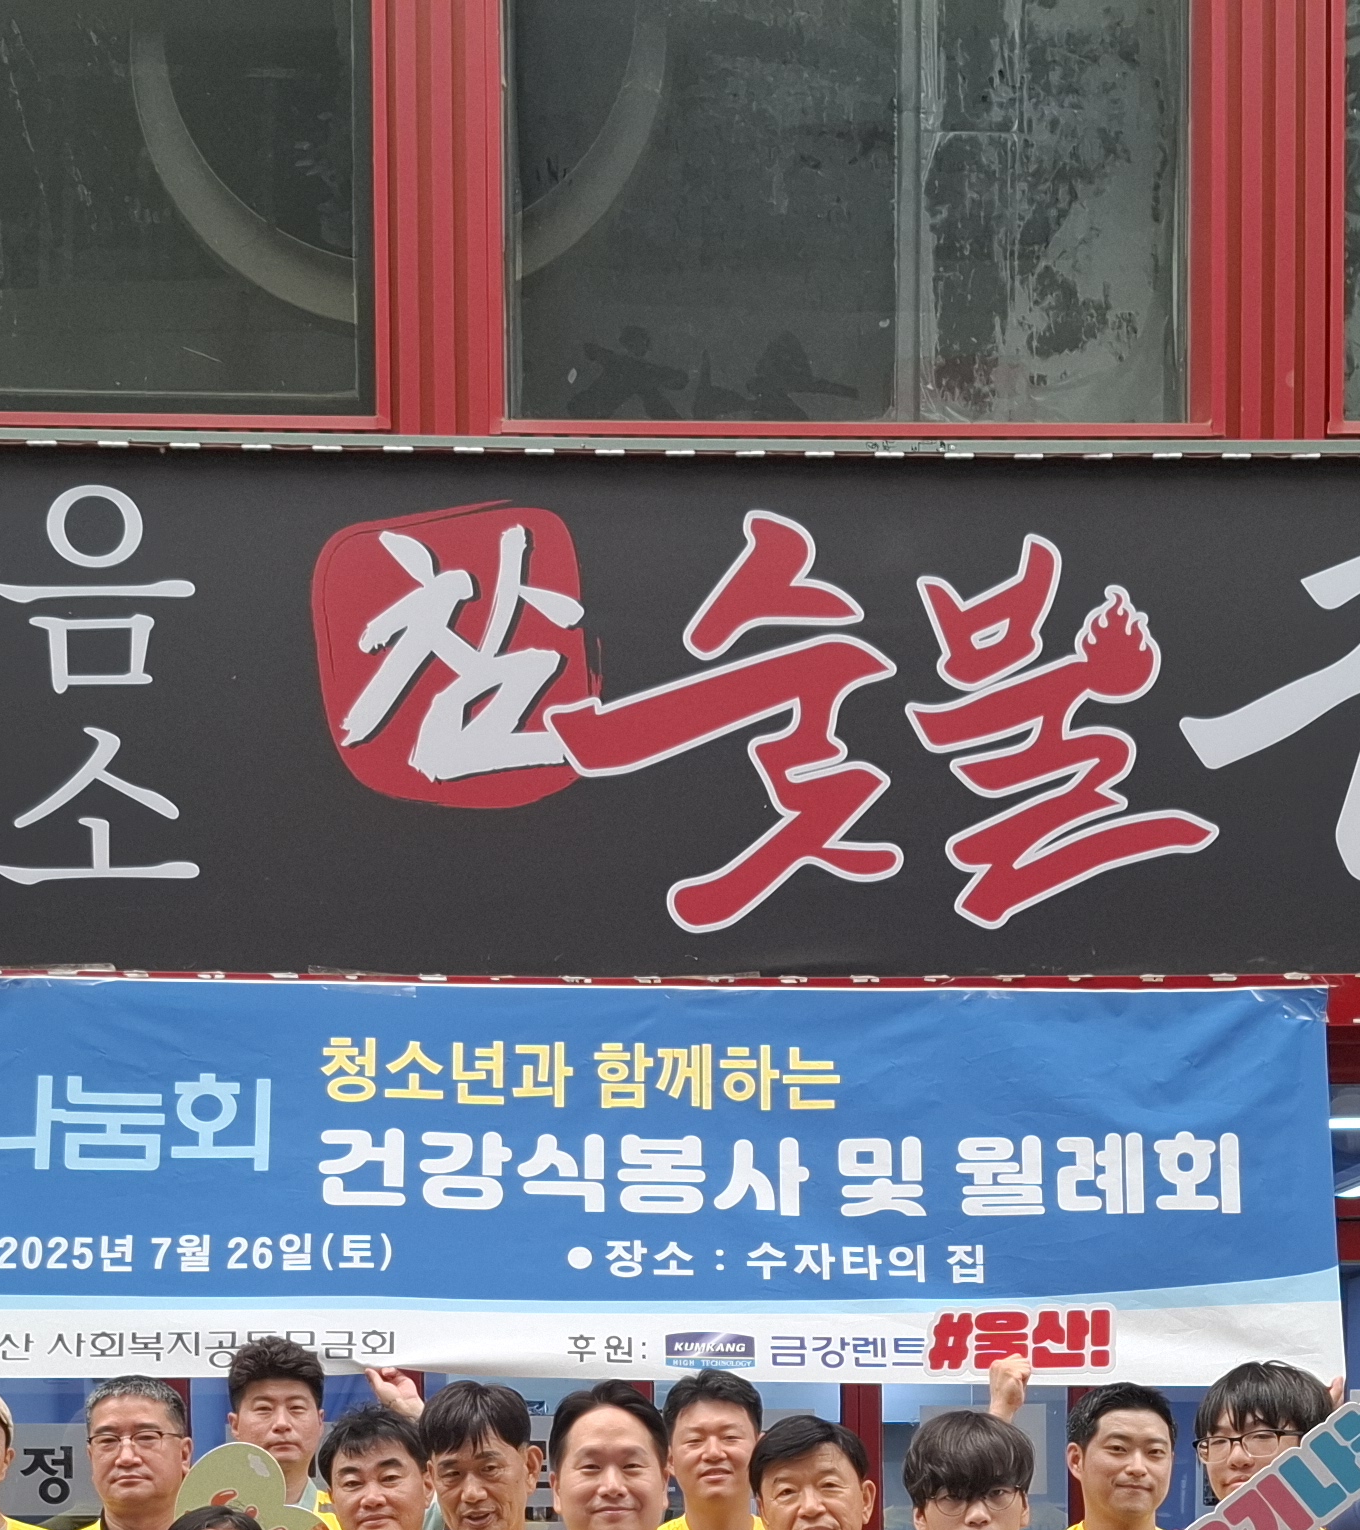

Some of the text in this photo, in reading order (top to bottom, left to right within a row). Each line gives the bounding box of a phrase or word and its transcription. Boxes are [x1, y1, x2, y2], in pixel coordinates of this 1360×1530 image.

[321, 1036, 841, 1111] 청소년과 함께하는
[319, 1127, 1242, 1217] 건강식봉사 및 월례회
[149, 1234, 213, 1272] 7월
[226, 1231, 393, 1274] 26일(토)
[605, 1239, 695, 1277] 장소
[746, 1242, 927, 1283] 수자타의
[948, 1243, 986, 1284] 집
[47, 1329, 395, 1368] 사회복지공금회
[567, 1333, 647, 1364] 후원:
[673, 1340, 746, 1353] KUMKANG
[928, 1309, 1111, 1369] #울산!
[672, 1359, 752, 1367] HIGH TECHNOLOGY
